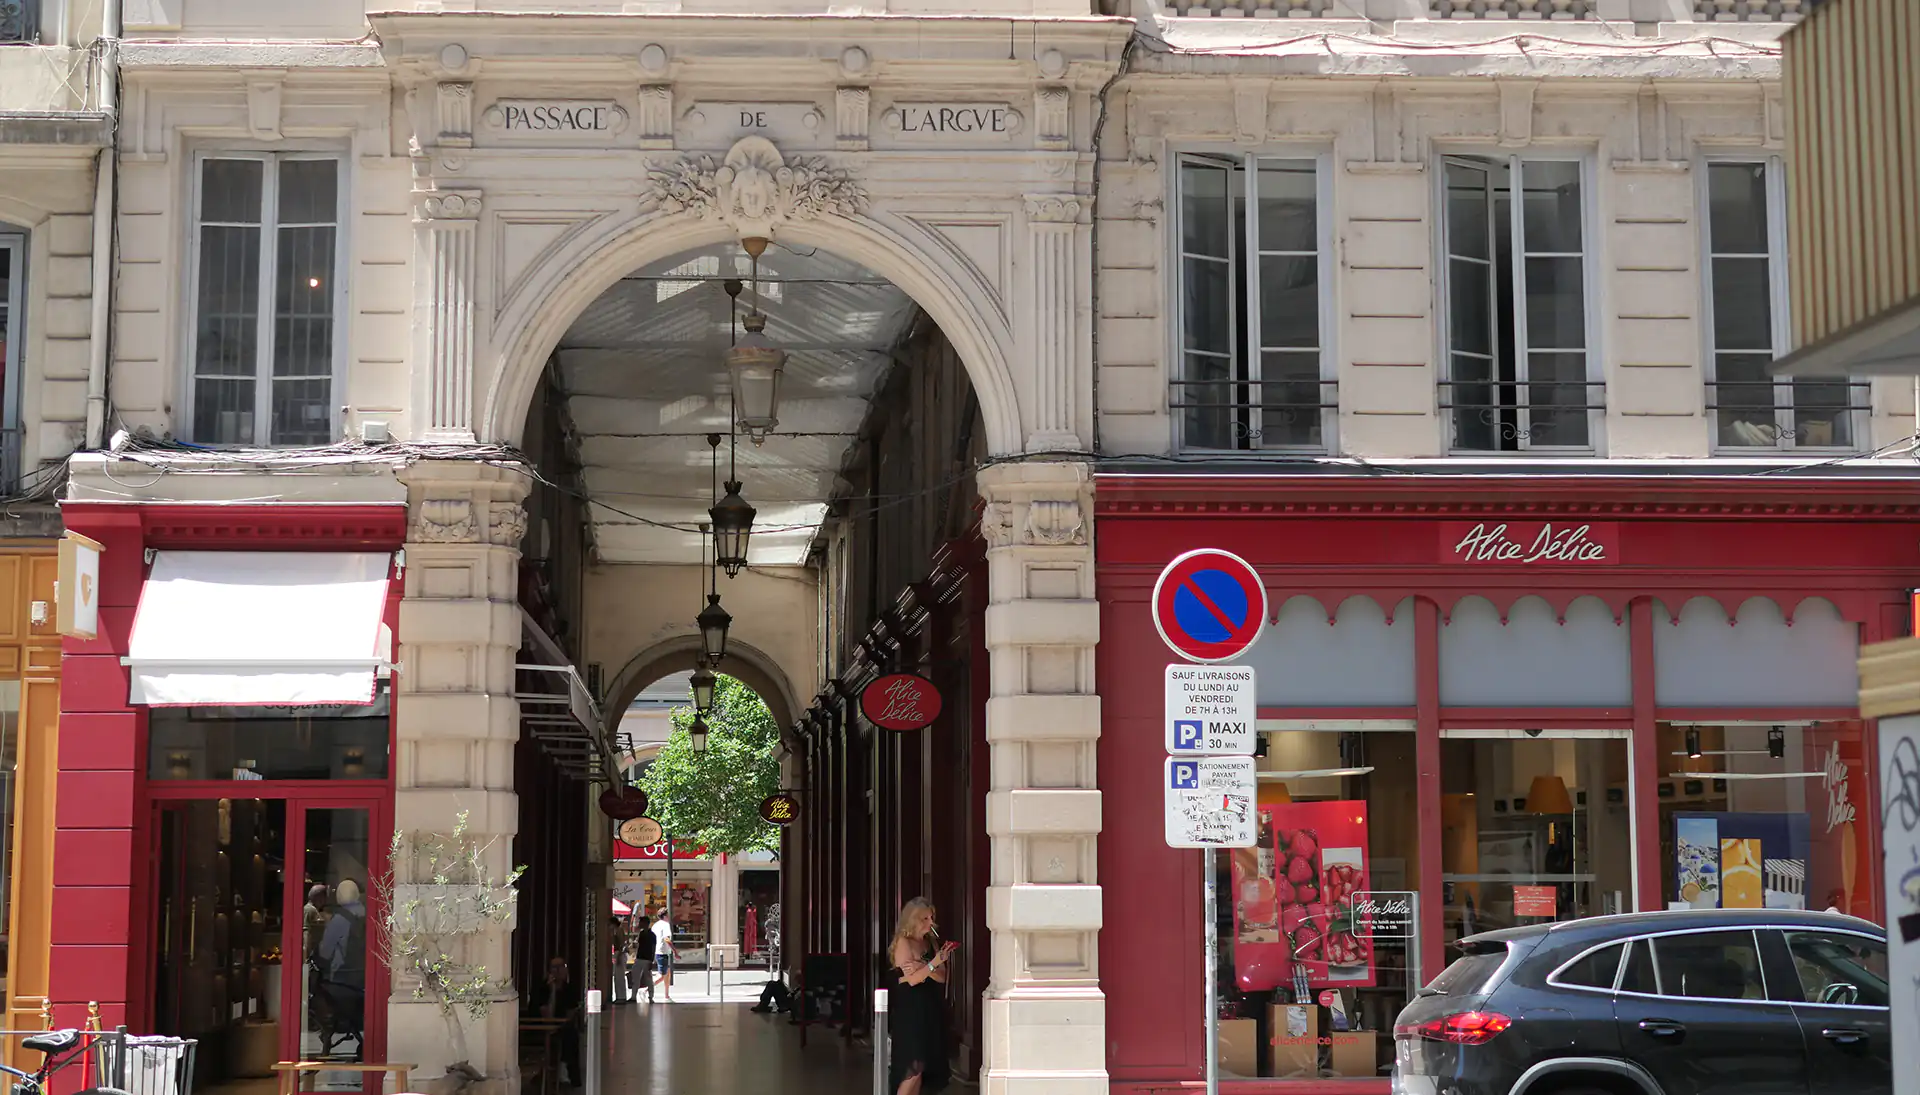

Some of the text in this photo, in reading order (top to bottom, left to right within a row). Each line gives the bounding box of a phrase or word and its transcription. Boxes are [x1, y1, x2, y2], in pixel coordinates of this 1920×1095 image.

[504, 106, 1006, 132] PASSAGE DE L'ARGVE
[1455, 523, 1606, 563] Alice Délice
[1172, 672, 1250, 681] SAUF LIVRAISONS
[884, 679, 922, 700] Alice
[1183, 683, 1239, 692] DU LUNDI AU
[1189, 695, 1234, 703] VENDREDI
[878, 699, 924, 721] Délice
[1185, 704, 1238, 715] DE 7H À 13H
[1209, 722, 1247, 735] MAXI
[1208, 738, 1222, 749] 30
[1822, 740, 1849, 792] Alice
[1356, 899, 1411, 915] Alice Délice
